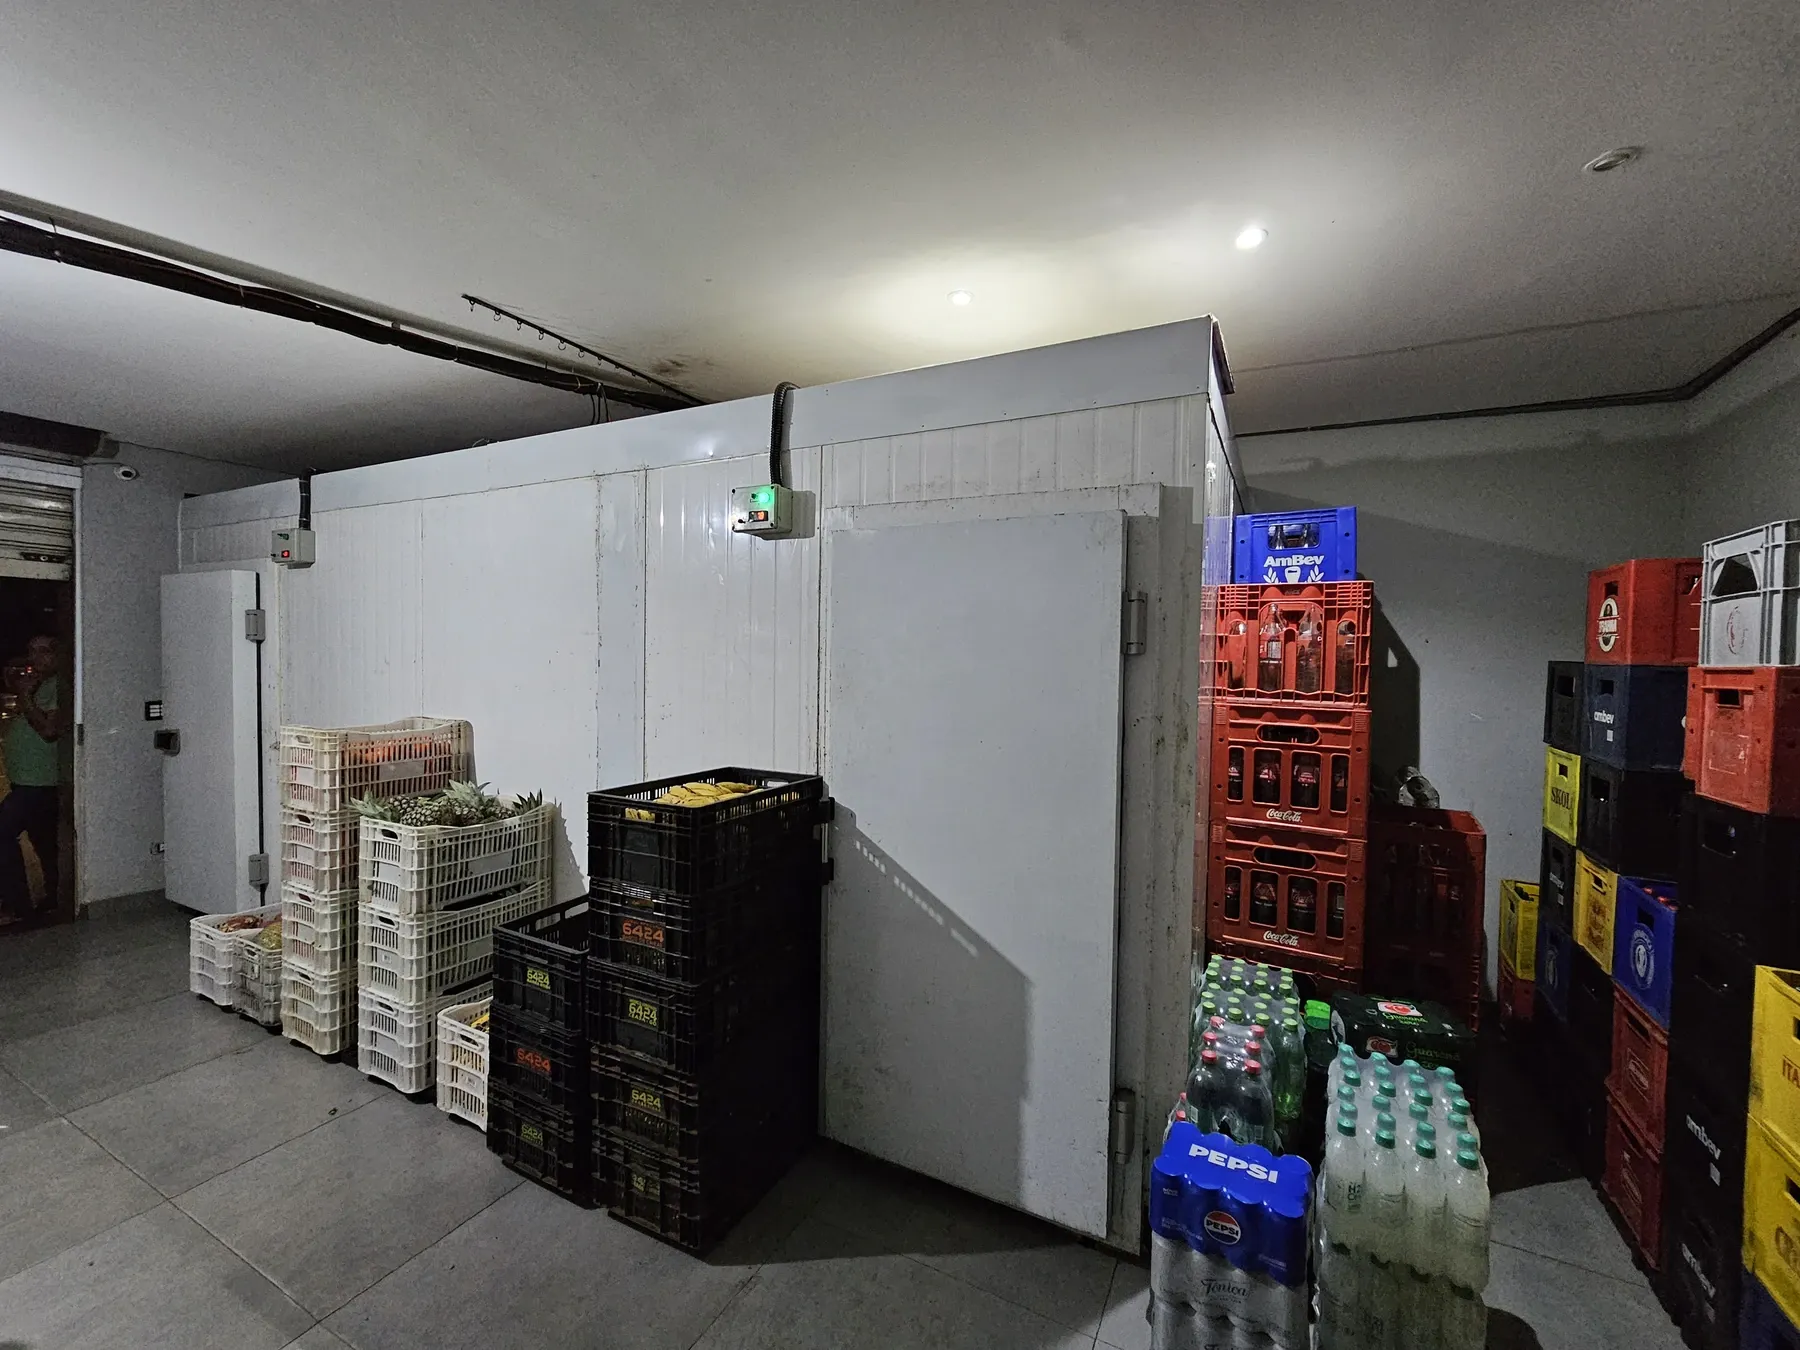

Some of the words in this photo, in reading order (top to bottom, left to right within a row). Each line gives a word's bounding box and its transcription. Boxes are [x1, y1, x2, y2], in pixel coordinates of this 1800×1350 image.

[1264, 555, 1325, 568] AmBev
[1551, 786, 1570, 810] SKOL
[622, 922, 665, 943] 6424
[527, 969, 550, 985] 6424
[628, 1002, 657, 1021] 6424
[517, 1048, 552, 1072] 6424
[631, 1089, 662, 1108] 6424
[521, 1124, 543, 1142] 6424
[1686, 1114, 1721, 1160] ambev
[1188, 1143, 1279, 1184] PEPSI
[1206, 1220, 1240, 1236] PEPSI
